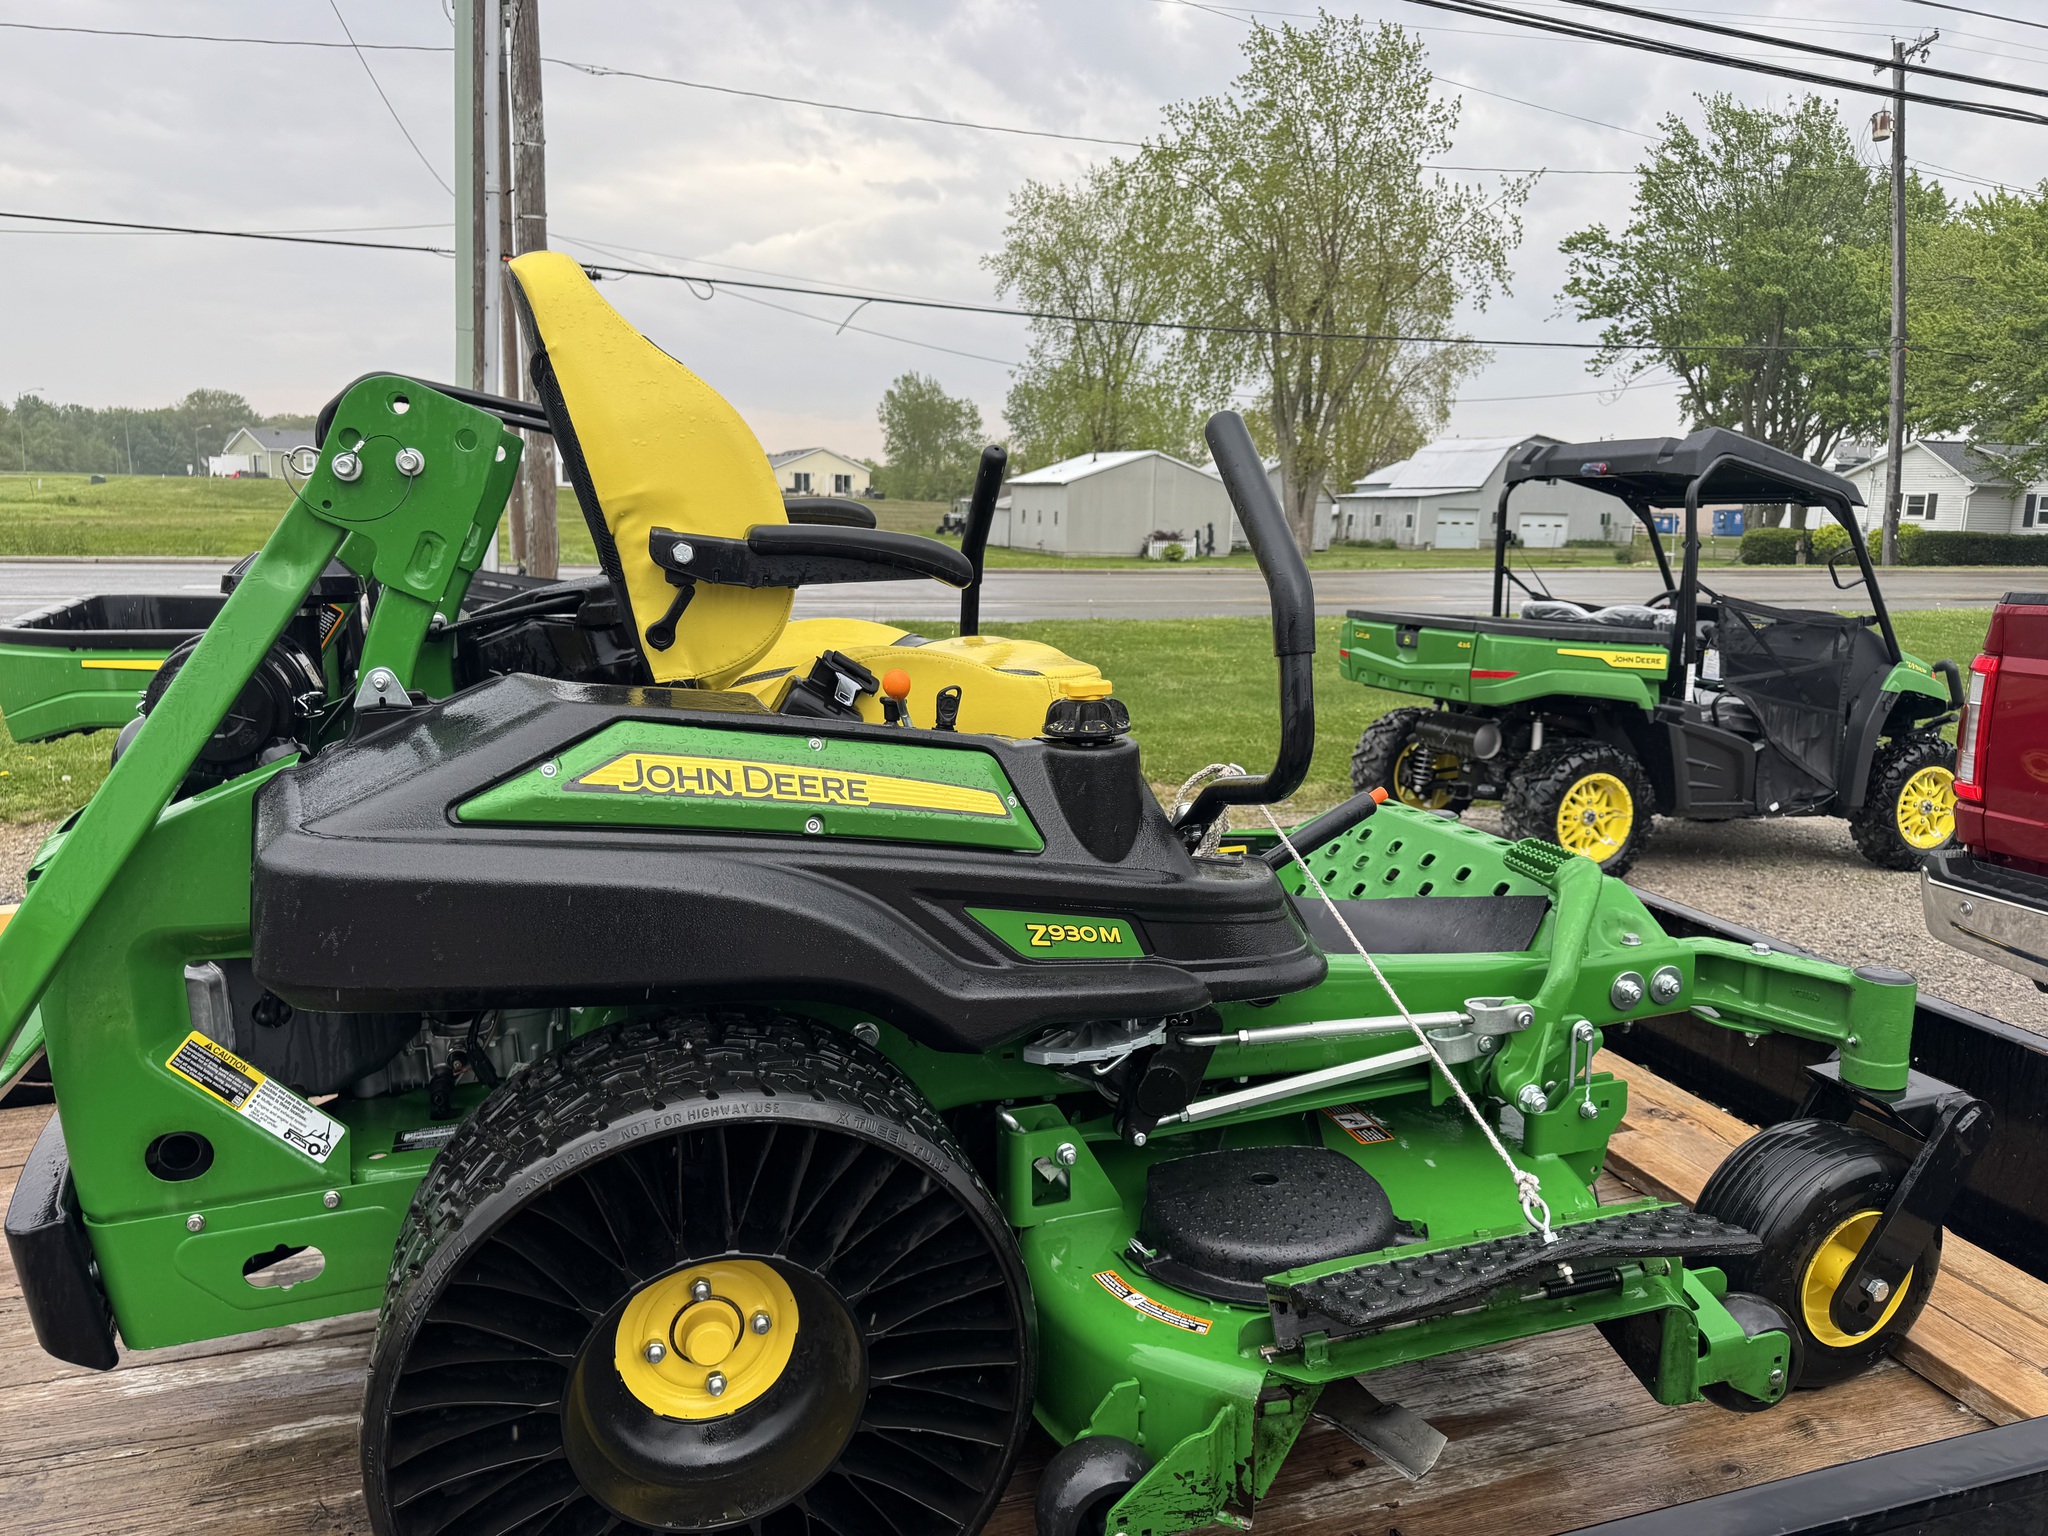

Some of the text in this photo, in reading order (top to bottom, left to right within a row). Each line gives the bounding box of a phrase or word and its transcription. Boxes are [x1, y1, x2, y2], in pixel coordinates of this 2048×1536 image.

[1613, 654, 1662, 665] JOHN DEERE
[623, 759, 869, 802] JOHN DEERE
[212, 1046, 248, 1072] CAUTION
[620, 1102, 780, 1140] NOT FOR HIGHWAY USE
[854, 1116, 908, 1149] TWEEL
[912, 1141, 950, 1173] TURF
[514, 1140, 608, 1198] 24X12N12 NHS
[399, 1231, 470, 1338] MICHELIN
